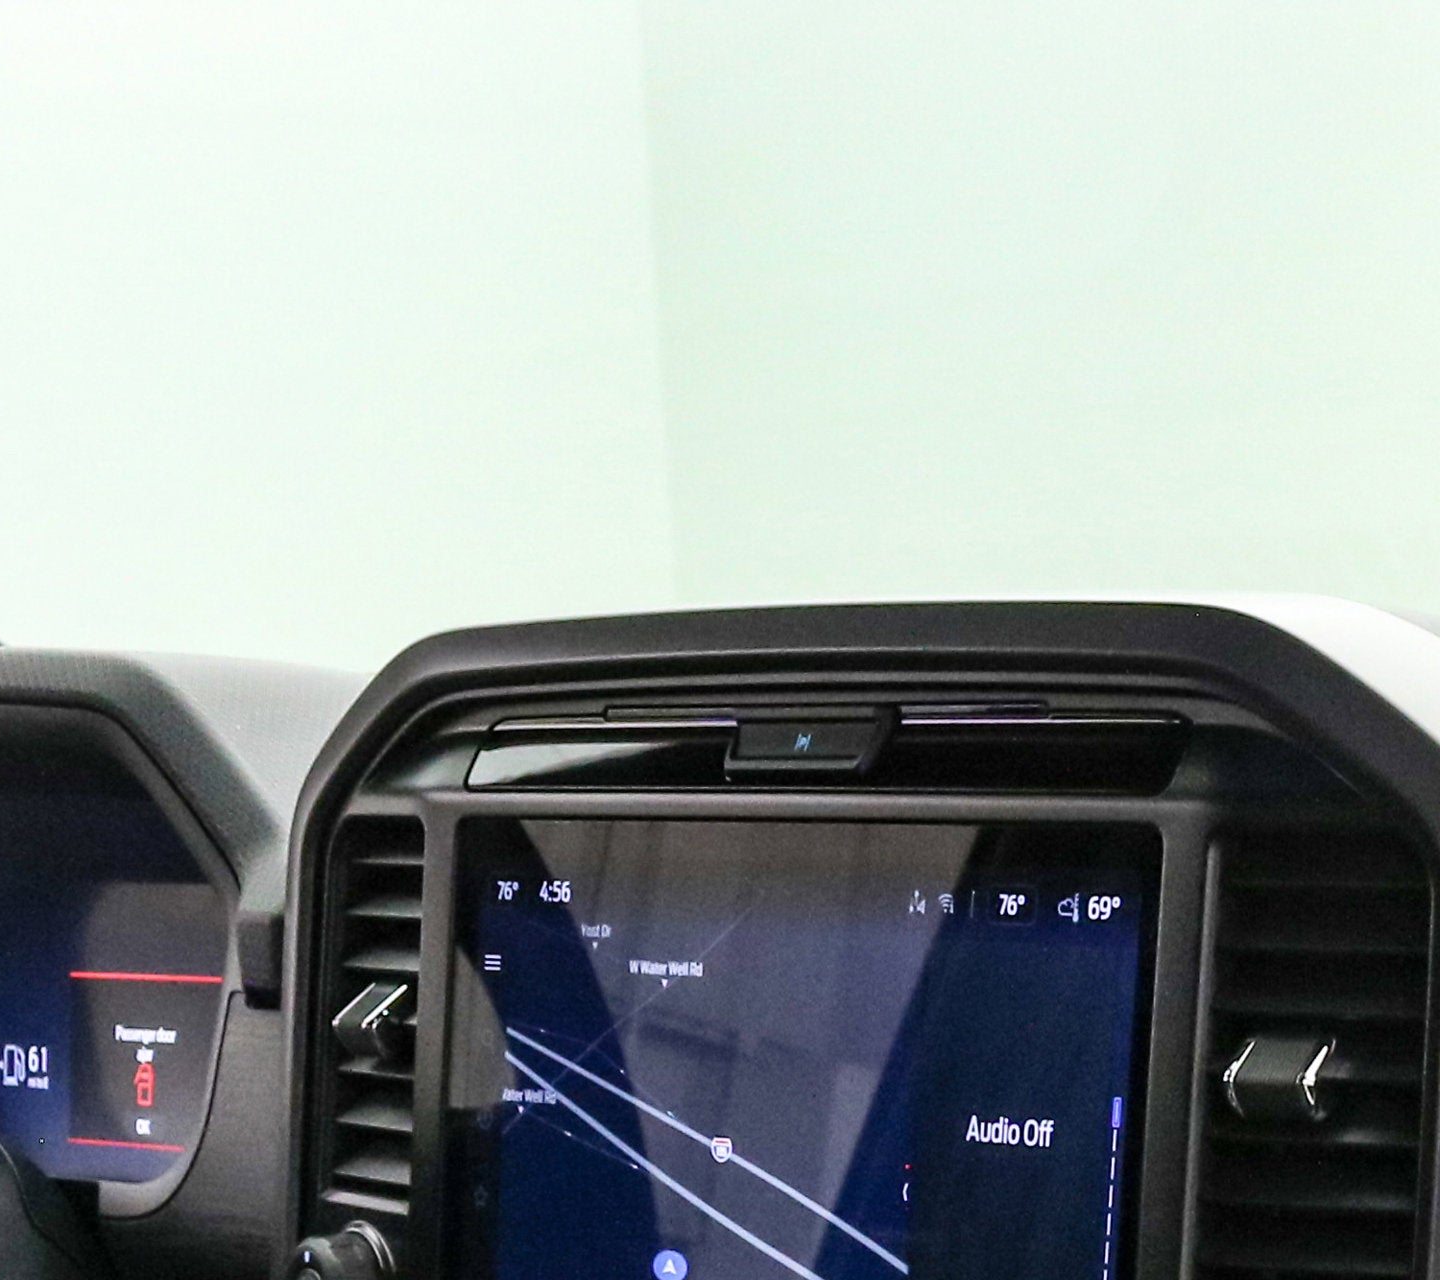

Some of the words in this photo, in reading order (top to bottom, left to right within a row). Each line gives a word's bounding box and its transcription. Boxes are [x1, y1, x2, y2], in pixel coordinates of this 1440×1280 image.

[539, 881, 571, 902] 4:56
[27, 1046, 48, 1073] 61
[965, 1115, 1020, 1145] Audio
[1023, 1119, 1055, 1148] Off
